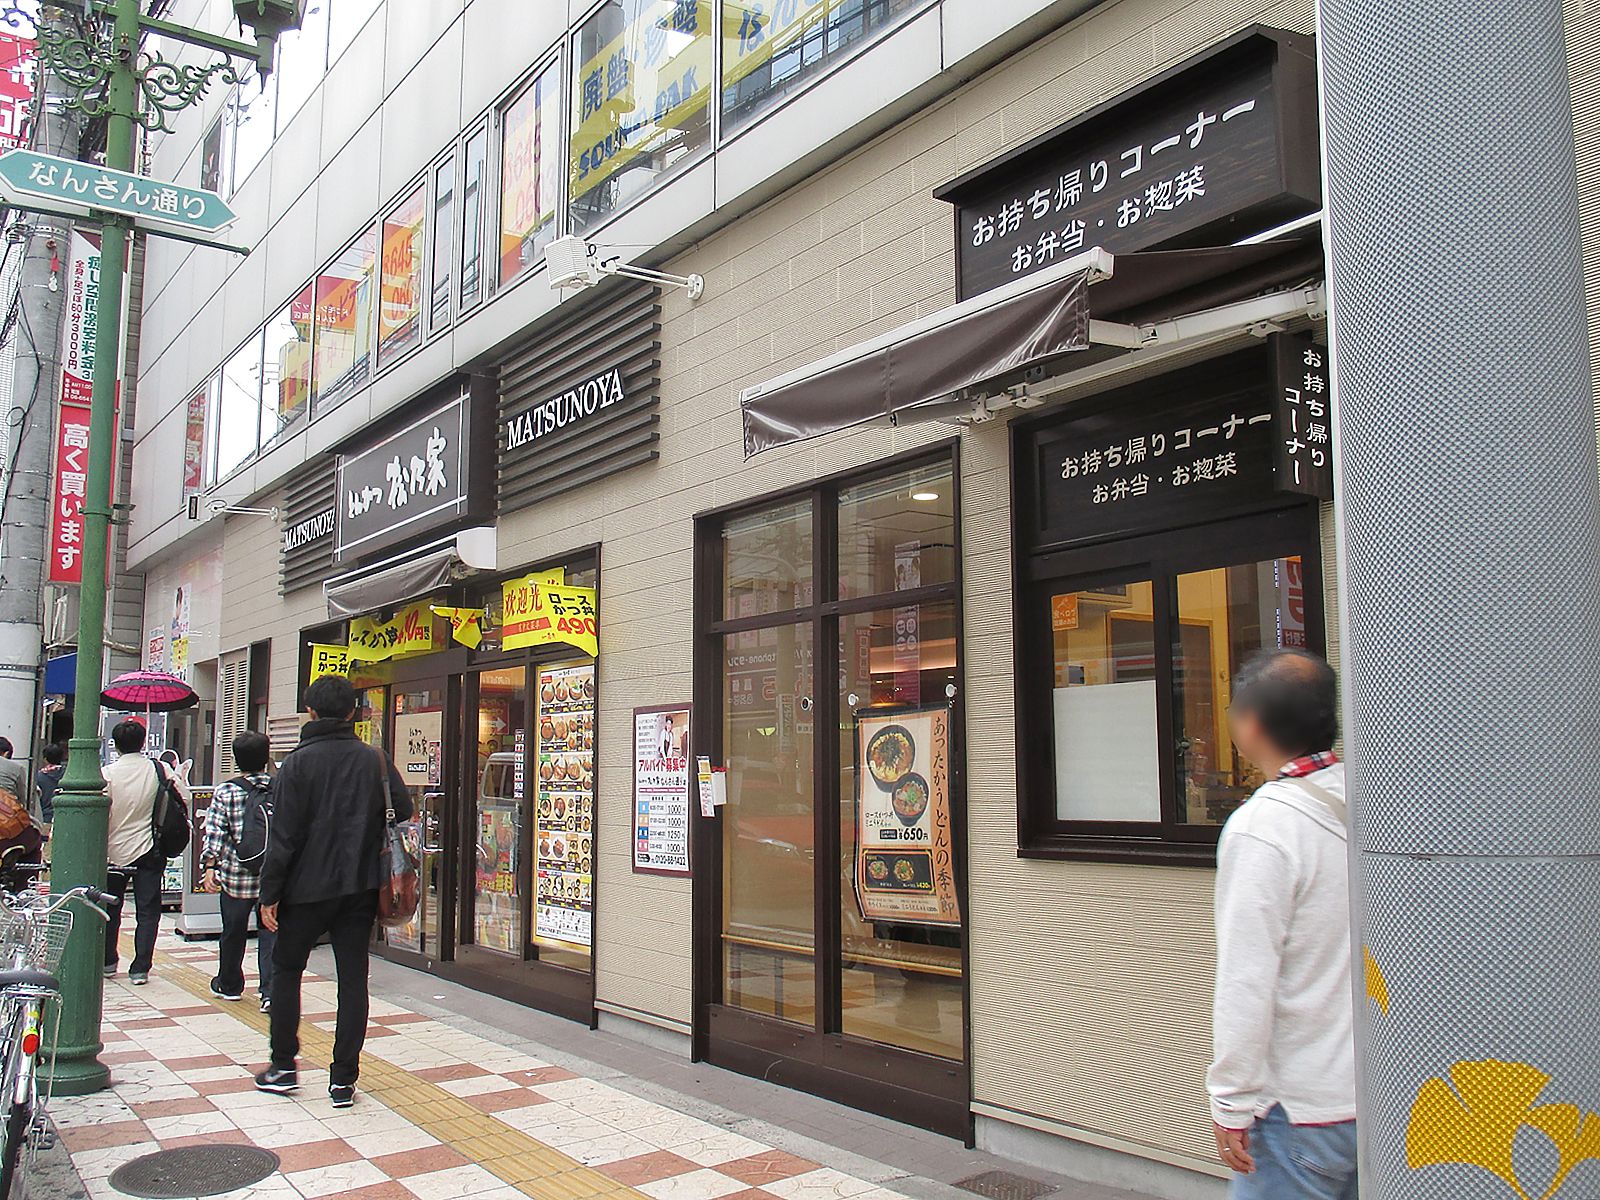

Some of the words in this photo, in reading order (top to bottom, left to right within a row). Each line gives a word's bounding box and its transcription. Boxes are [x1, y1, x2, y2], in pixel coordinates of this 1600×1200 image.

[30, 161, 206, 219] なんさん通り
[972, 100, 1255, 247] お持ち帰りコーナー
[1011, 165, 1206, 273] お弁当・お惣菜
[506, 368, 624, 451] MATSUNOYA
[1285, 387, 1306, 485] コーナー
[1303, 349, 1327, 467] お持ち帰り
[1061, 413, 1272, 479] お持ち帰りコーナー
[1092, 452, 1237, 504] お弁当・お惣菜
[58, 423, 90, 569] 高く買います
[548, 592, 591, 605] ロース
[552, 604, 595, 616] かつ丼
[557, 617, 597, 637] 490
[317, 662, 348, 673] かつ丼
[319, 652, 347, 661] ロース
[933, 716, 955, 914] あったかうどんの季節
